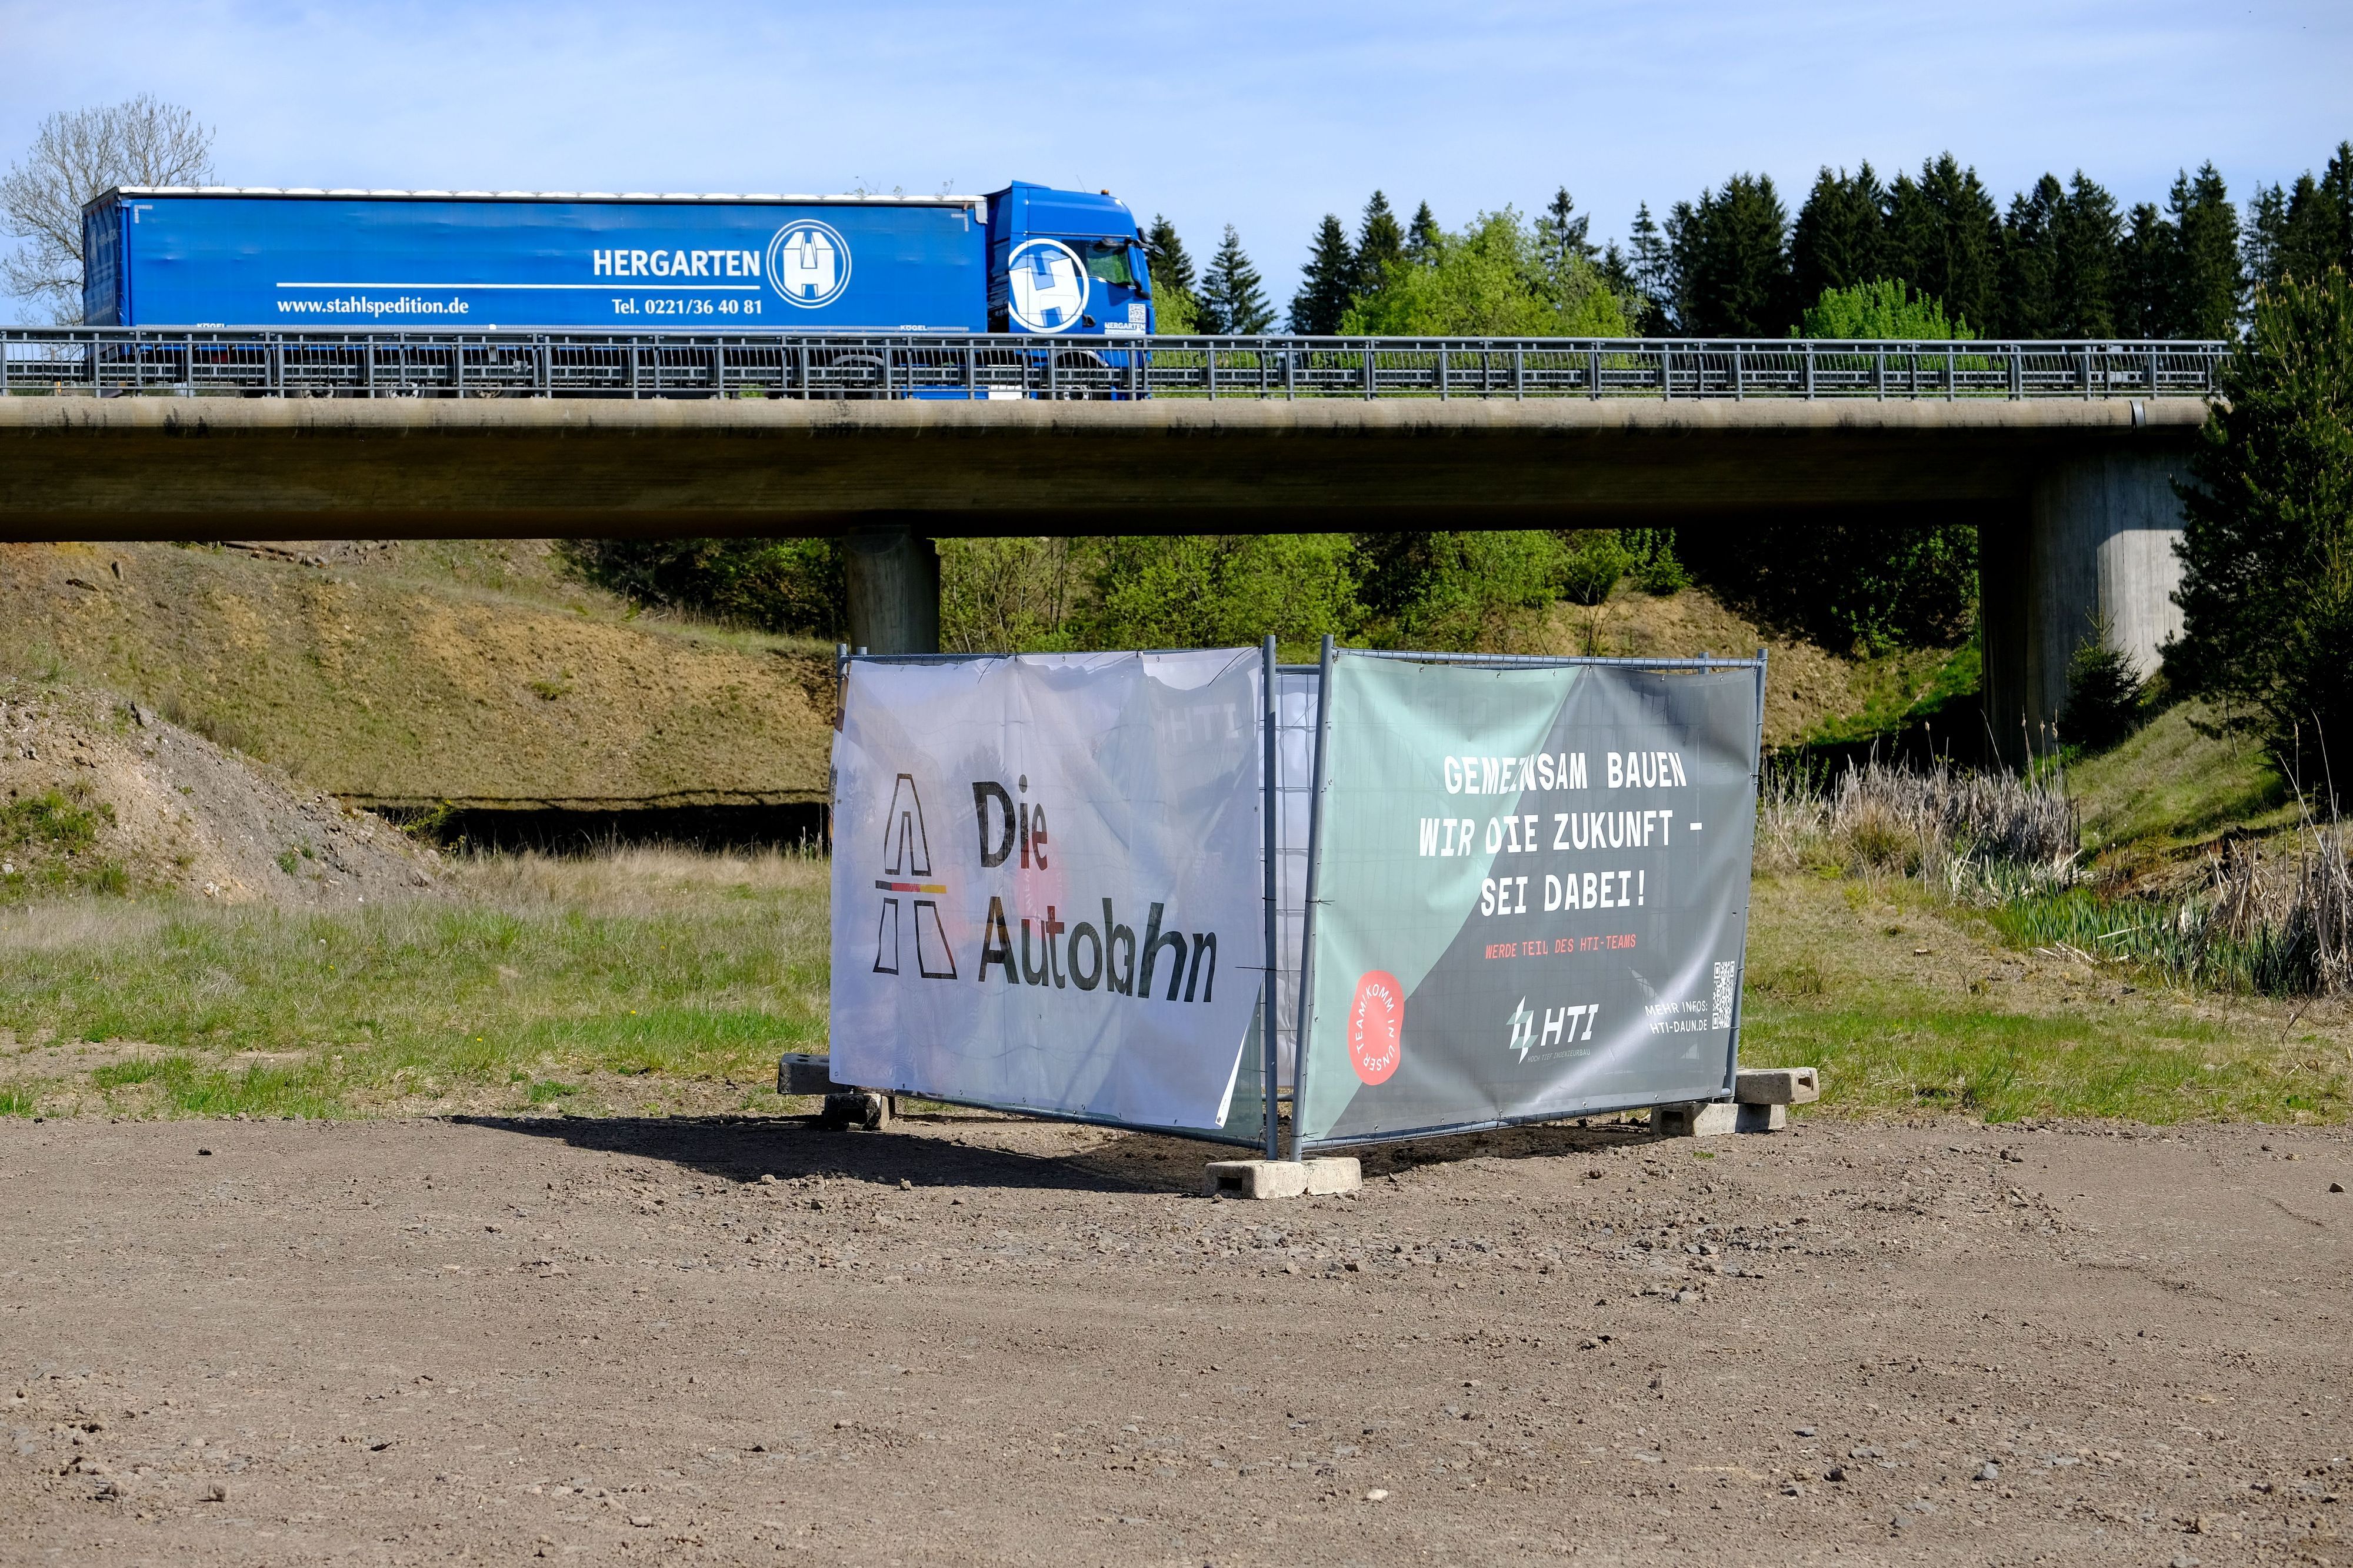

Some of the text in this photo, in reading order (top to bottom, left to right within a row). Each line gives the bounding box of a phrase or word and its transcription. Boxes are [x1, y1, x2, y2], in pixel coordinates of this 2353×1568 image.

[594, 249, 761, 277] HERGARTEN
[276, 296, 469, 318] www.stahlspedition.de
[611, 298, 762, 315] Tel. 0221/36 40 81
[1105, 322, 1146, 330] HERGARTEN
[1444, 752, 1687, 795] GEMEINSAM BAUEN
[972, 774, 1048, 871] Die
[1419, 818, 1475, 857] WIR
[1485, 815, 1538, 853] DIE
[1553, 810, 1673, 850] ZUKUNFT
[1481, 870, 1645, 916] SEI DABEI!
[978, 896, 1217, 1003] Autobahn
[1485, 933, 1637, 959] WERDE TEIL DES HTI-TEAMS
[1645, 1000, 1708, 1016] MEHR INFOS:
[1355, 983, 1395, 1071] KOMM IN UNSER TEAM!
[1540, 1004, 1599, 1046] HTI
[1649, 1019, 1707, 1034] HTI-DAUN.DE
[1554, 1049, 1590, 1059] INGENIEURBAU
